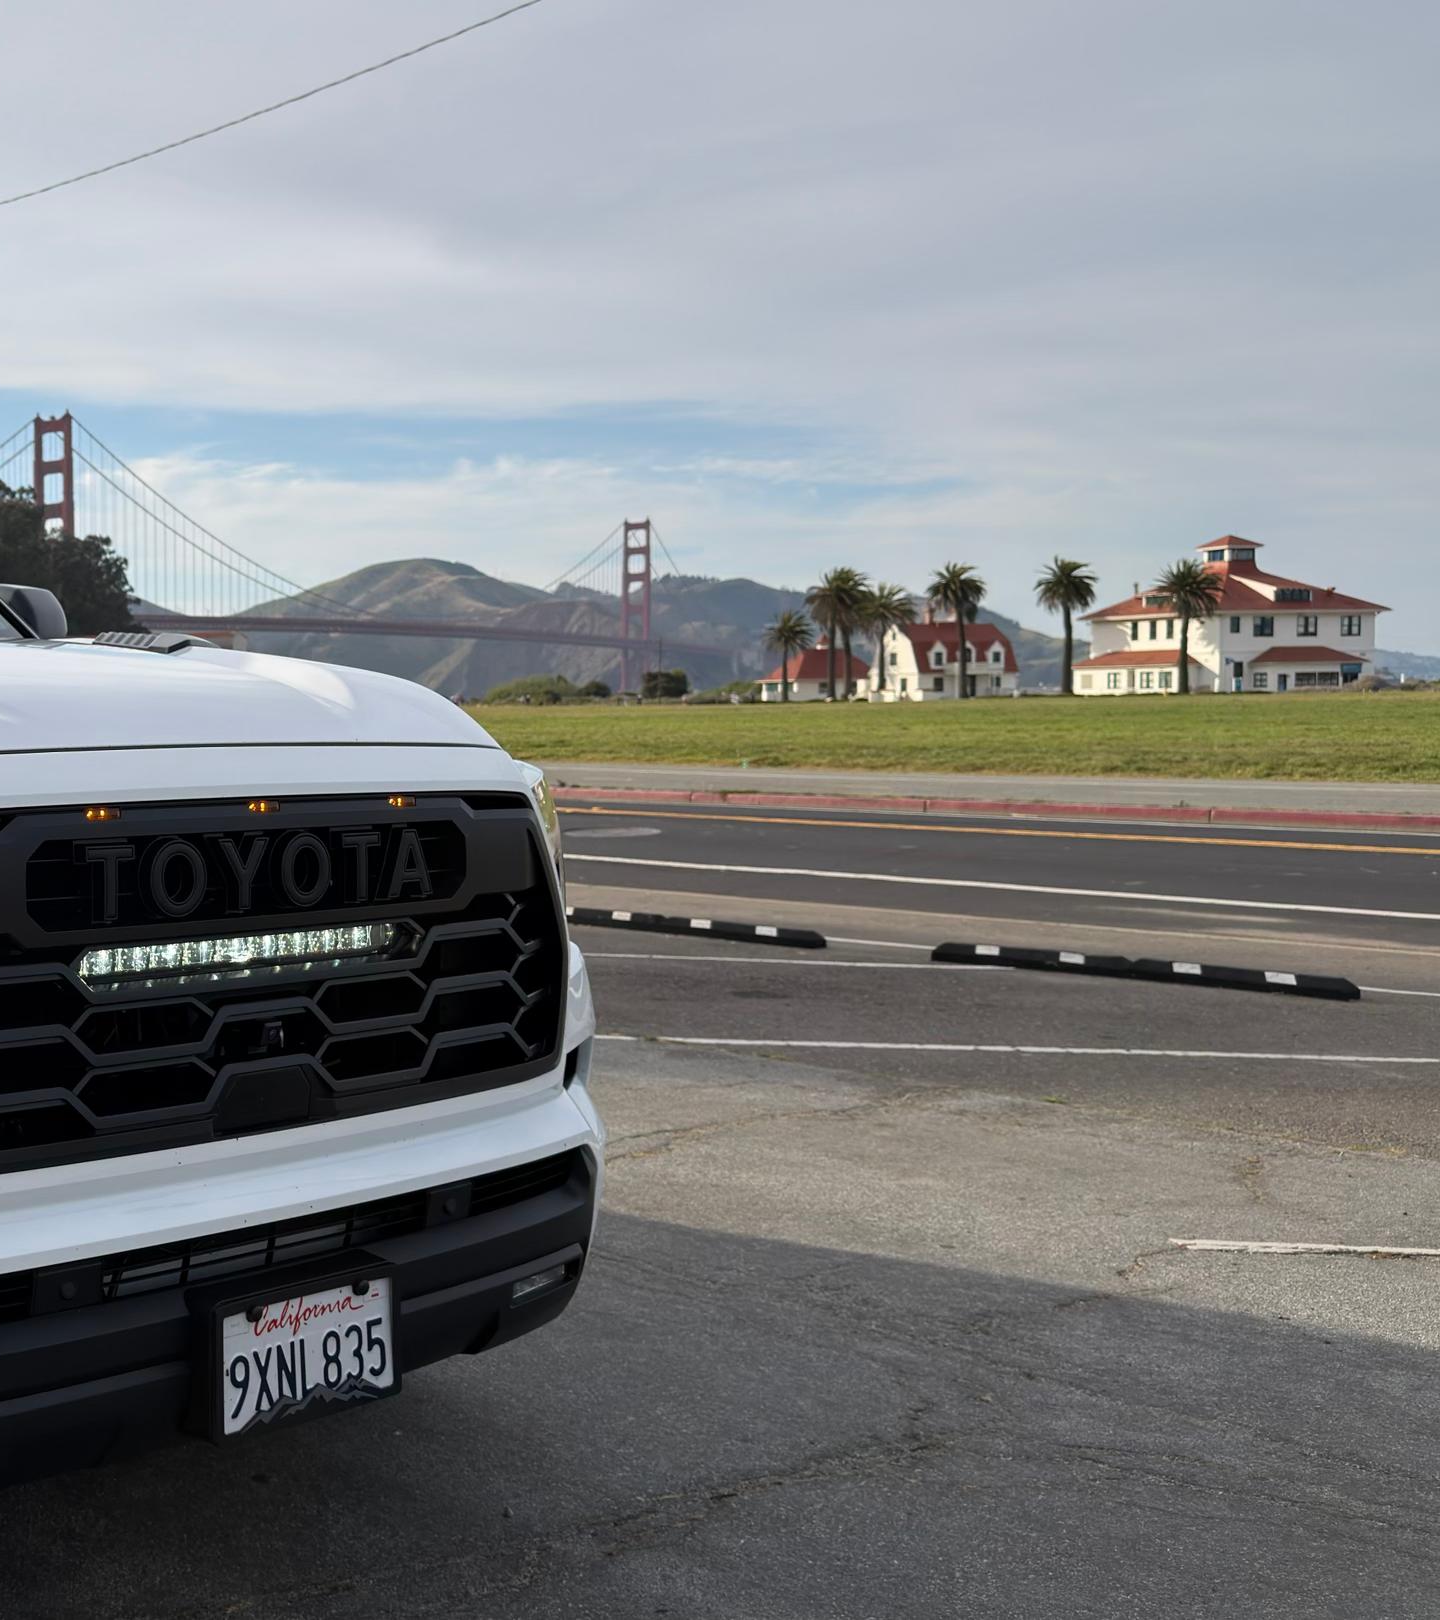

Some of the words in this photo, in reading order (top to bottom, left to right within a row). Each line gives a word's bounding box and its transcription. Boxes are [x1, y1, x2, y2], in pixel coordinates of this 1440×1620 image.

[83, 828, 433, 921] TOYOTA
[254, 1296, 364, 1336] California
[322, 1317, 387, 1389] 835
